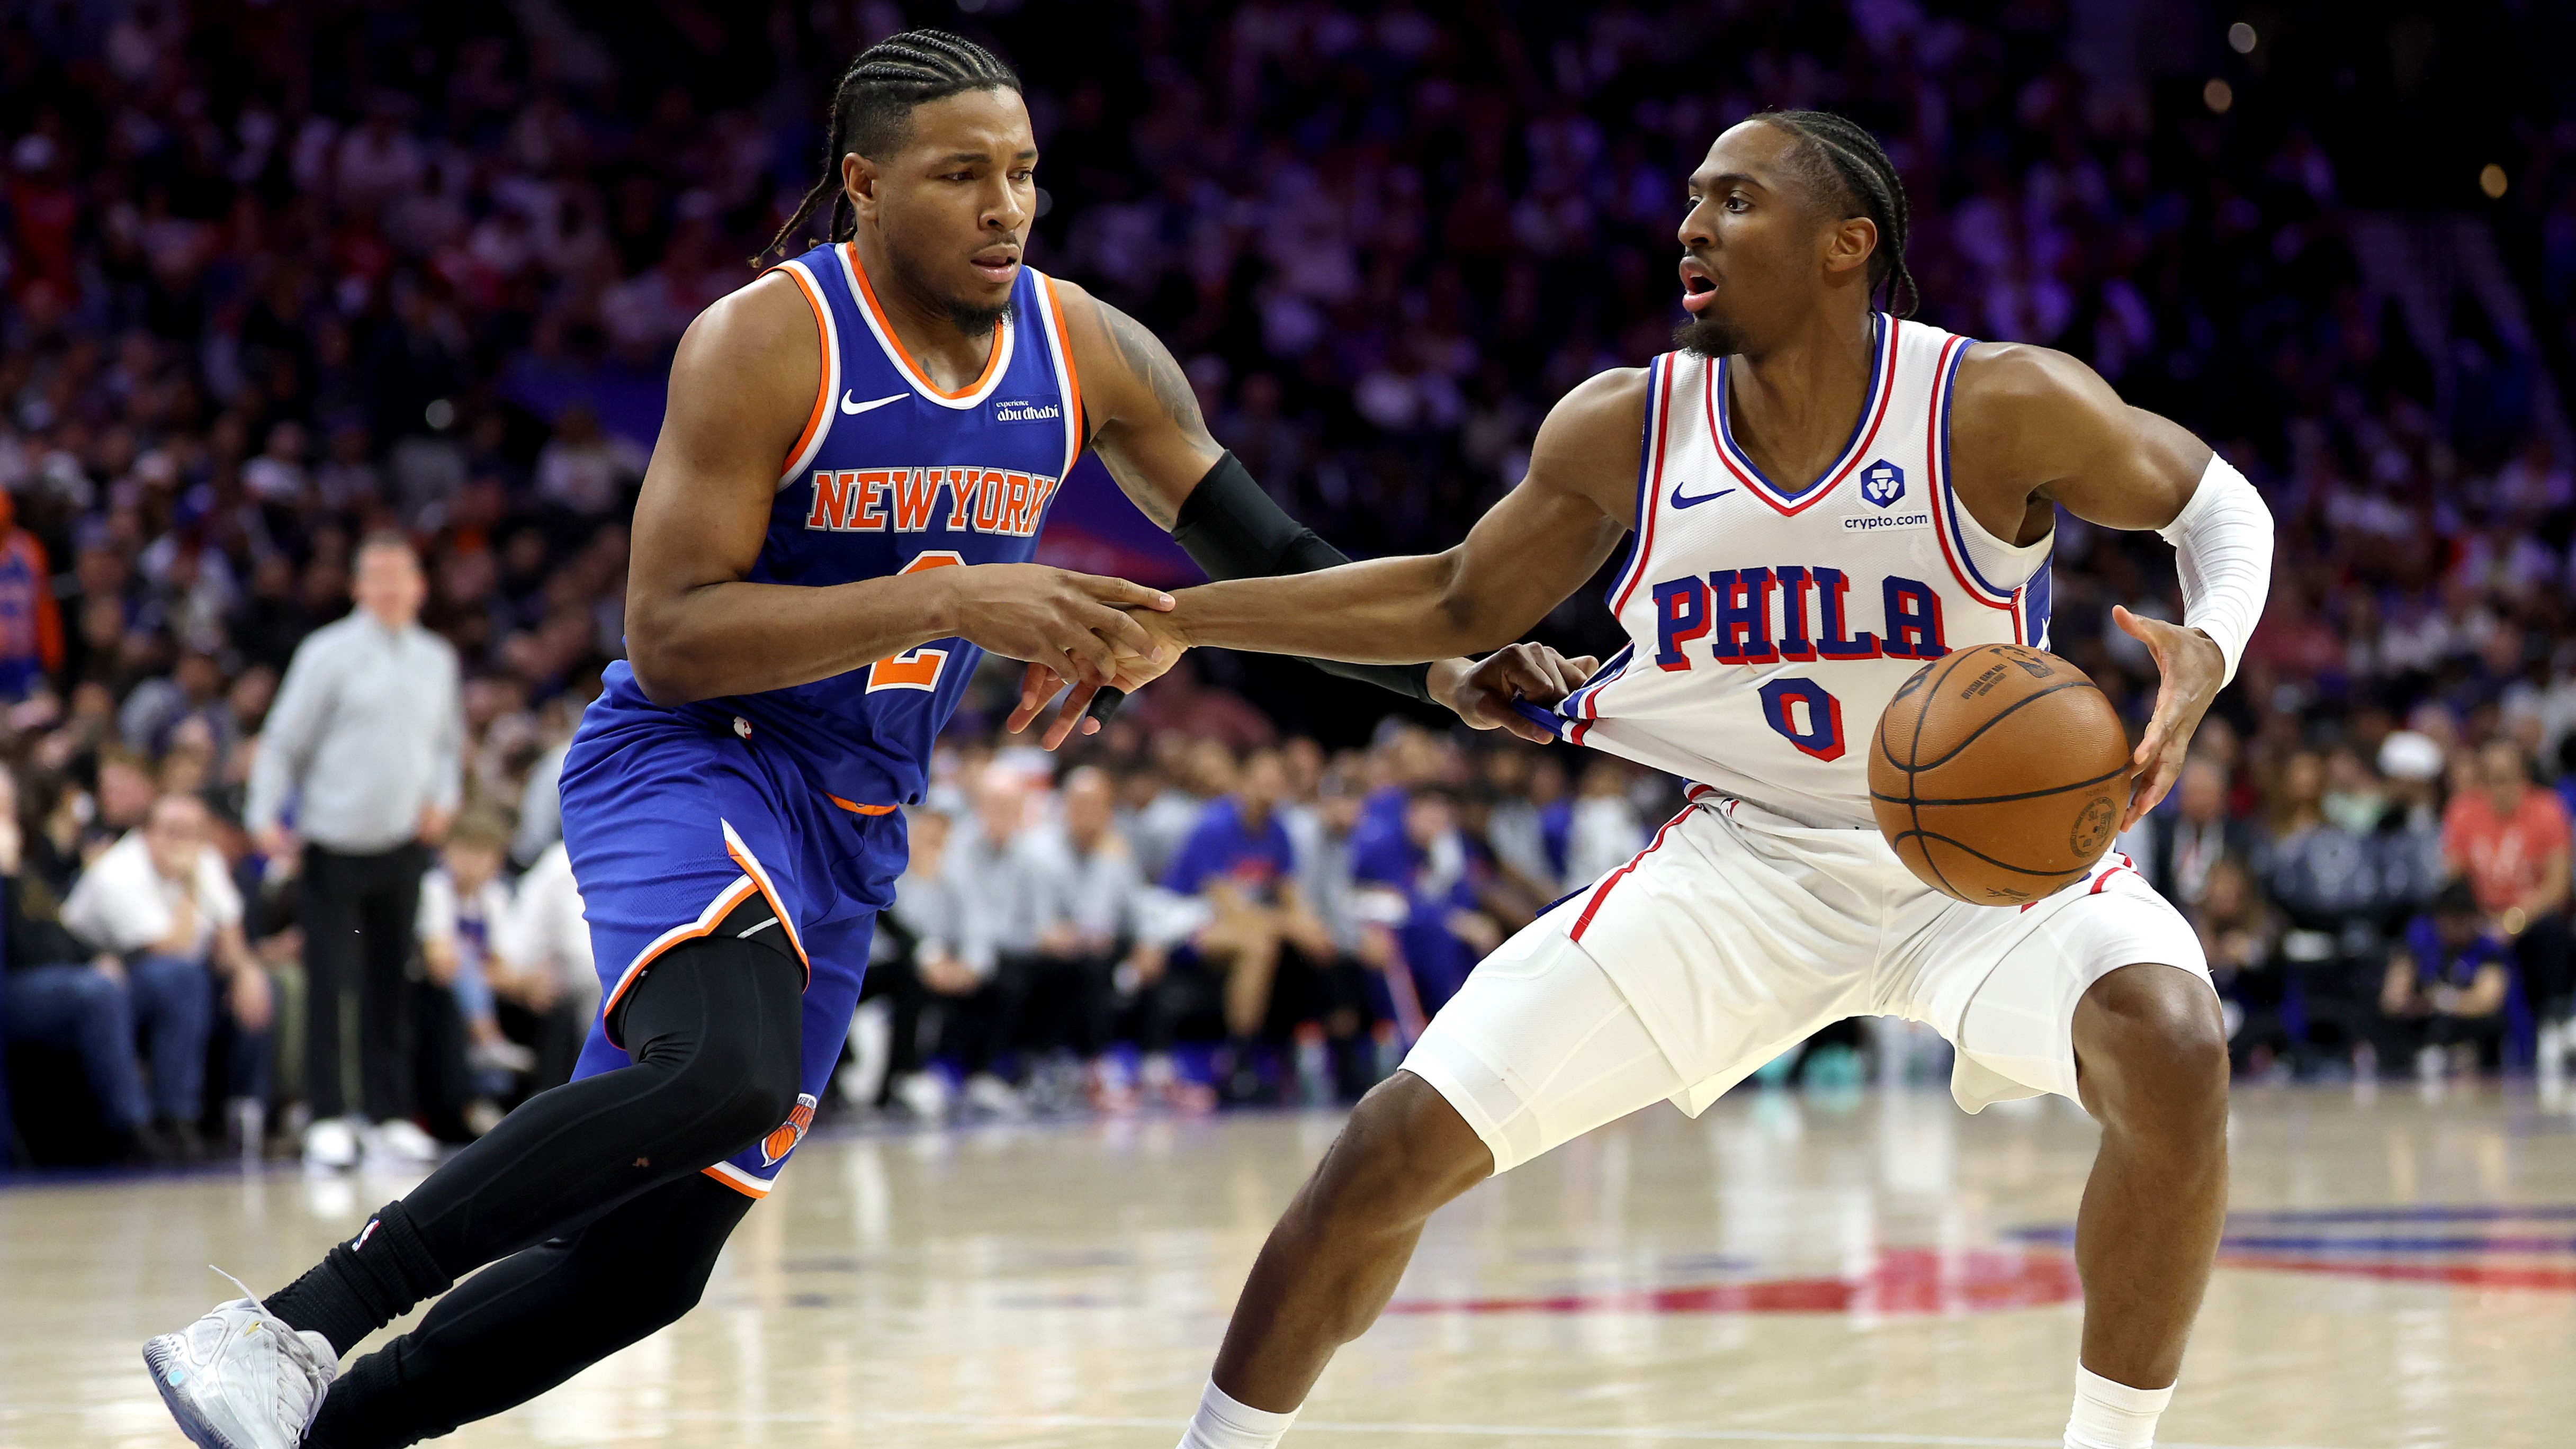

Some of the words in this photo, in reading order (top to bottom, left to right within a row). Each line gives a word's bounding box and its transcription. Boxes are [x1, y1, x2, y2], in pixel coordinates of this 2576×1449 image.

[997, 408, 1022, 421] abu
[1022, 404, 1059, 420] dhabi
[805, 466, 946, 533] NEW
[946, 466, 1057, 537] YORK
[1845, 515, 1927, 529] crypto.com
[1653, 565, 1952, 672] PHILA
[1757, 678, 1845, 762] 0
